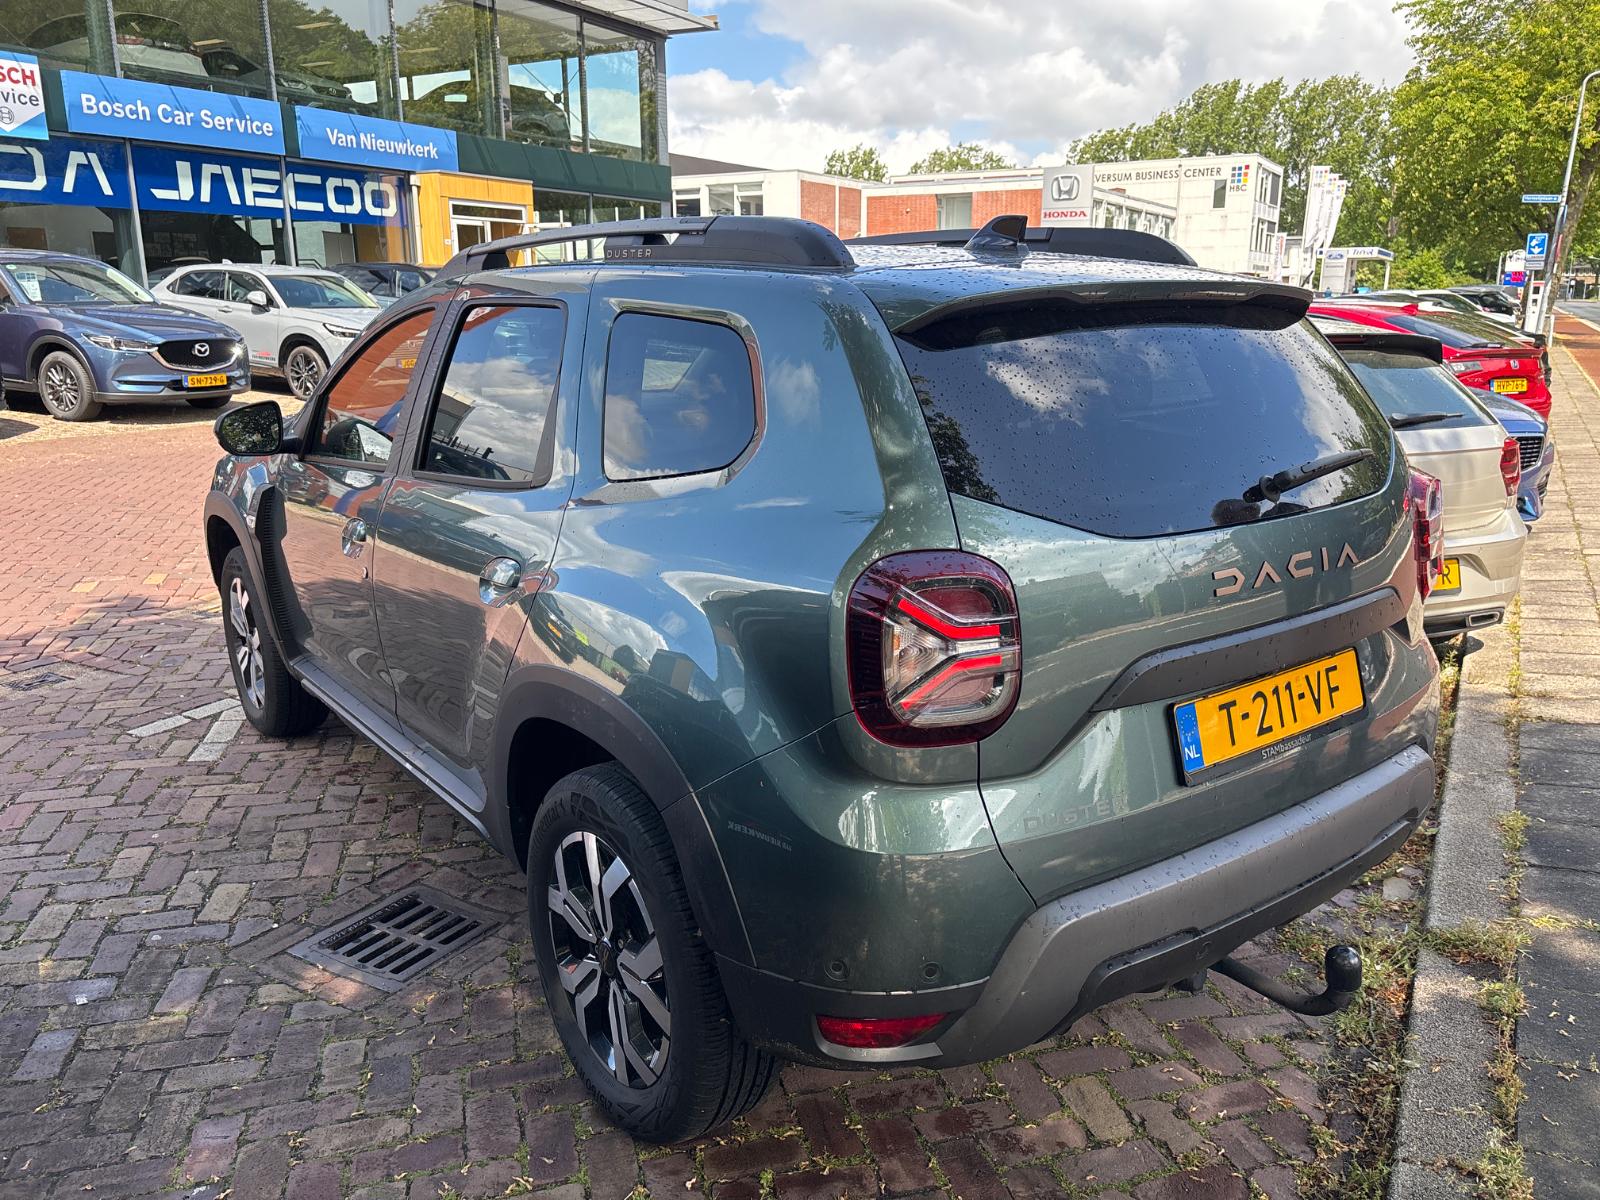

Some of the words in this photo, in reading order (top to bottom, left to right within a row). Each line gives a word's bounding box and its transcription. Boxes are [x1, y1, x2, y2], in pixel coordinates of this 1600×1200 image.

[80, 93, 151, 121] Bosch
[157, 103, 194, 126] Car
[200, 109, 274, 137] Service
[325, 127, 357, 148] Van
[359, 132, 439, 159] Nieuwkerk
[1094, 173, 1133, 183] VERSUM
[1135, 169, 1180, 181] BUSINESS
[1184, 167, 1222, 178] CENTER
[150, 160, 398, 218] JAECOO
[1229, 184, 1248, 193] HBC
[1043, 210, 1088, 219] HONDA
[606, 248, 653, 258] DUSTER
[190, 375, 225, 386] SN-729-G
[1212, 542, 1360, 597] DACIA
[1218, 665, 1340, 747] T-211-VF
[1184, 744, 1201, 761] NL
